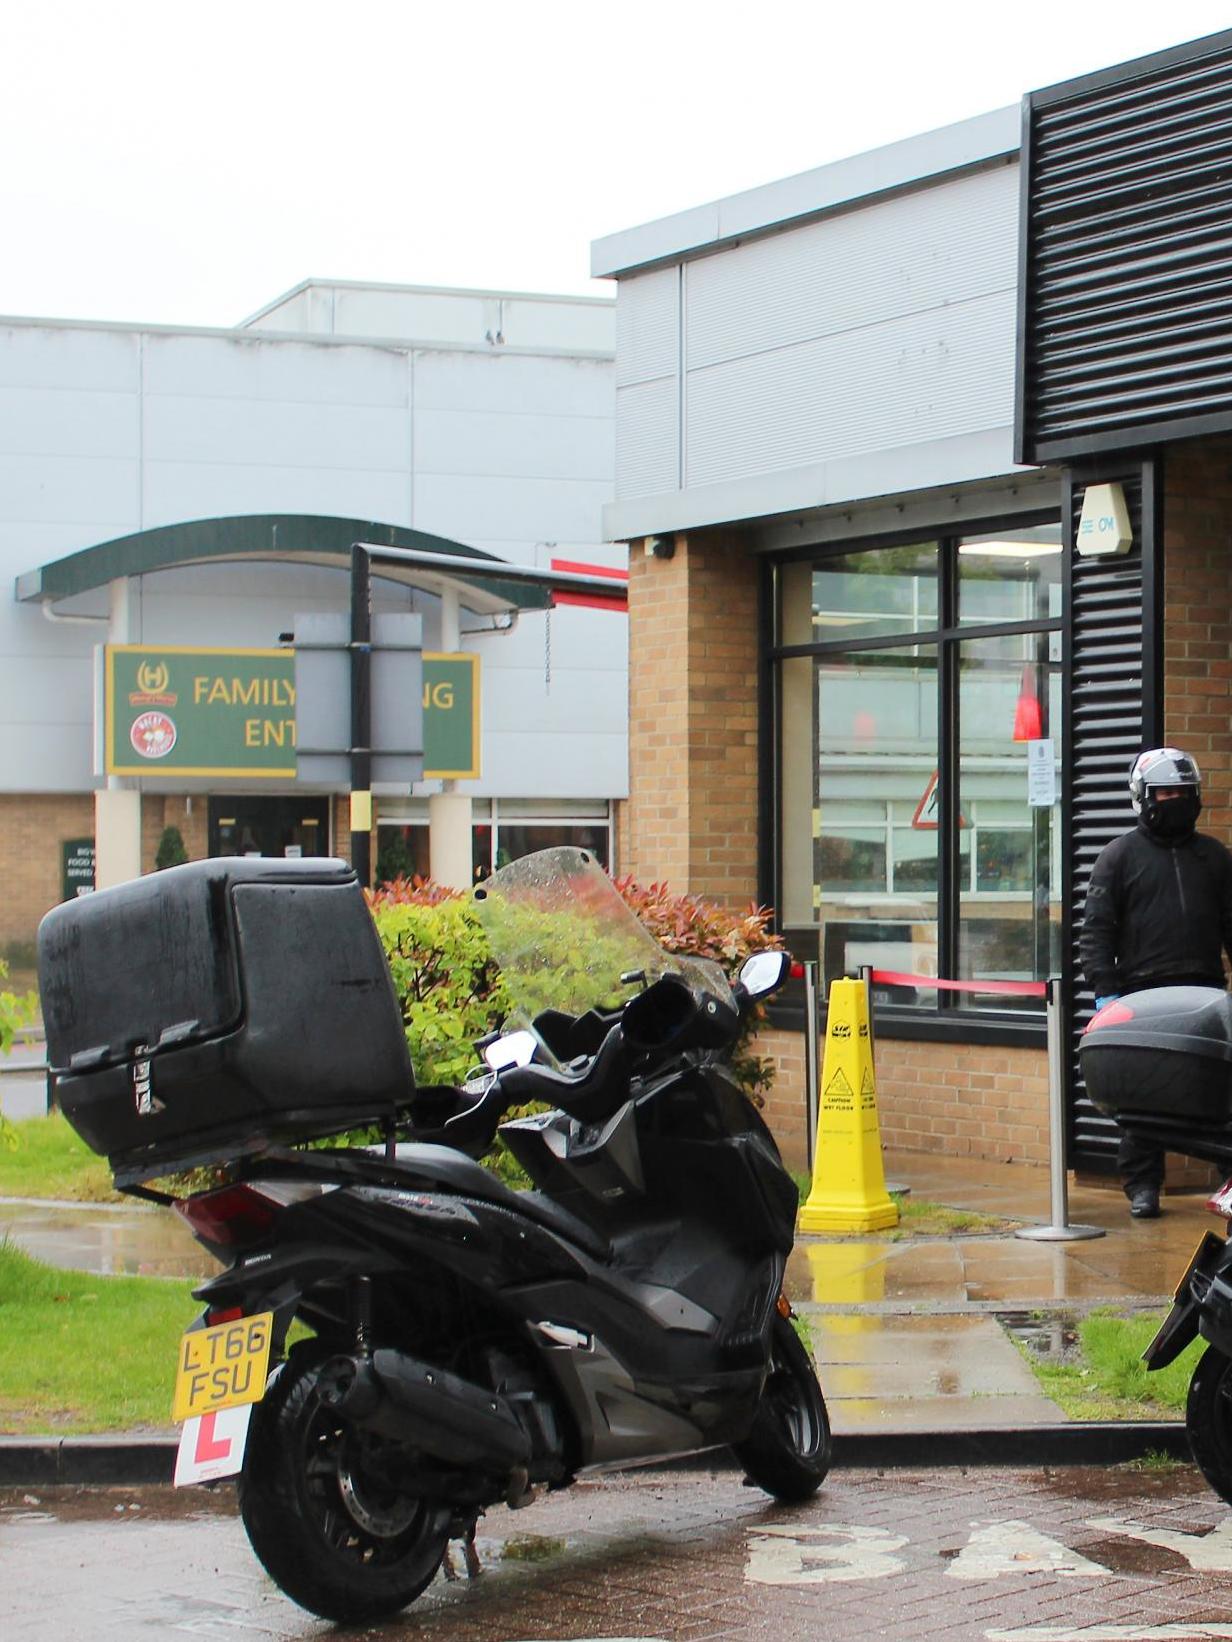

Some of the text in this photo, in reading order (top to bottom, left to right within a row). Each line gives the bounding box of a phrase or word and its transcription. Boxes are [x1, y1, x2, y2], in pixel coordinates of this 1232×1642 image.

[193, 677, 296, 706] FAMILY
[183, 1321, 266, 1373] LT66
[189, 1361, 252, 1407] FSU
[194, 1411, 232, 1465] L
